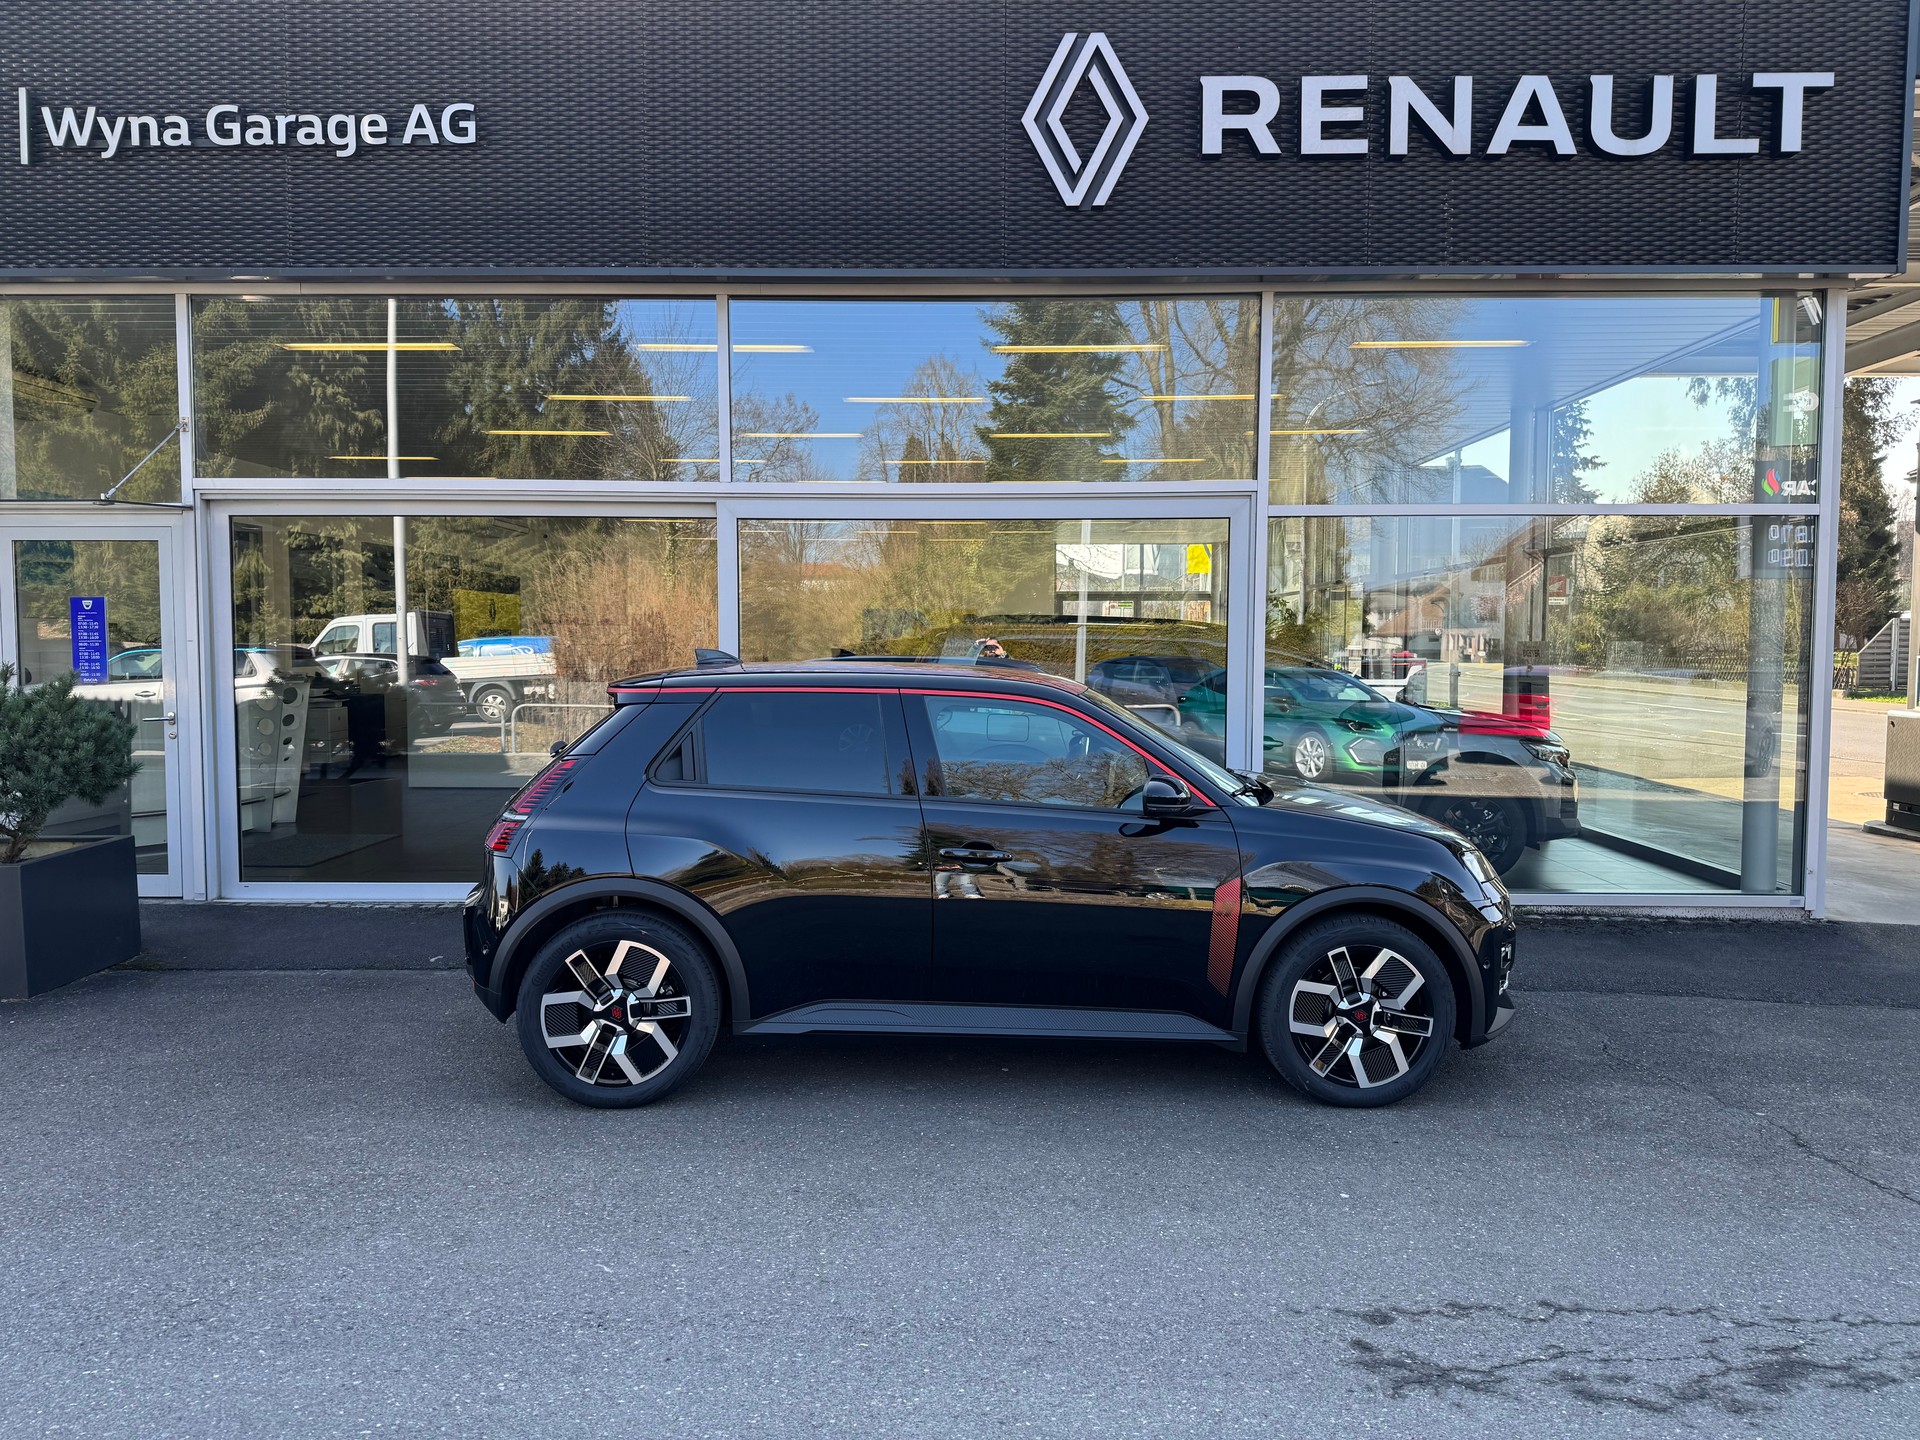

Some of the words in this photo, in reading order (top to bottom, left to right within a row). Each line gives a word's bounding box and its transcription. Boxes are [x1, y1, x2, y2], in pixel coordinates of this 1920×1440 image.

[41, 105, 192, 159] Wyna
[205, 103, 389, 158] Garage
[401, 102, 477, 146] AG
[1199, 71, 1836, 157] RENAULT
